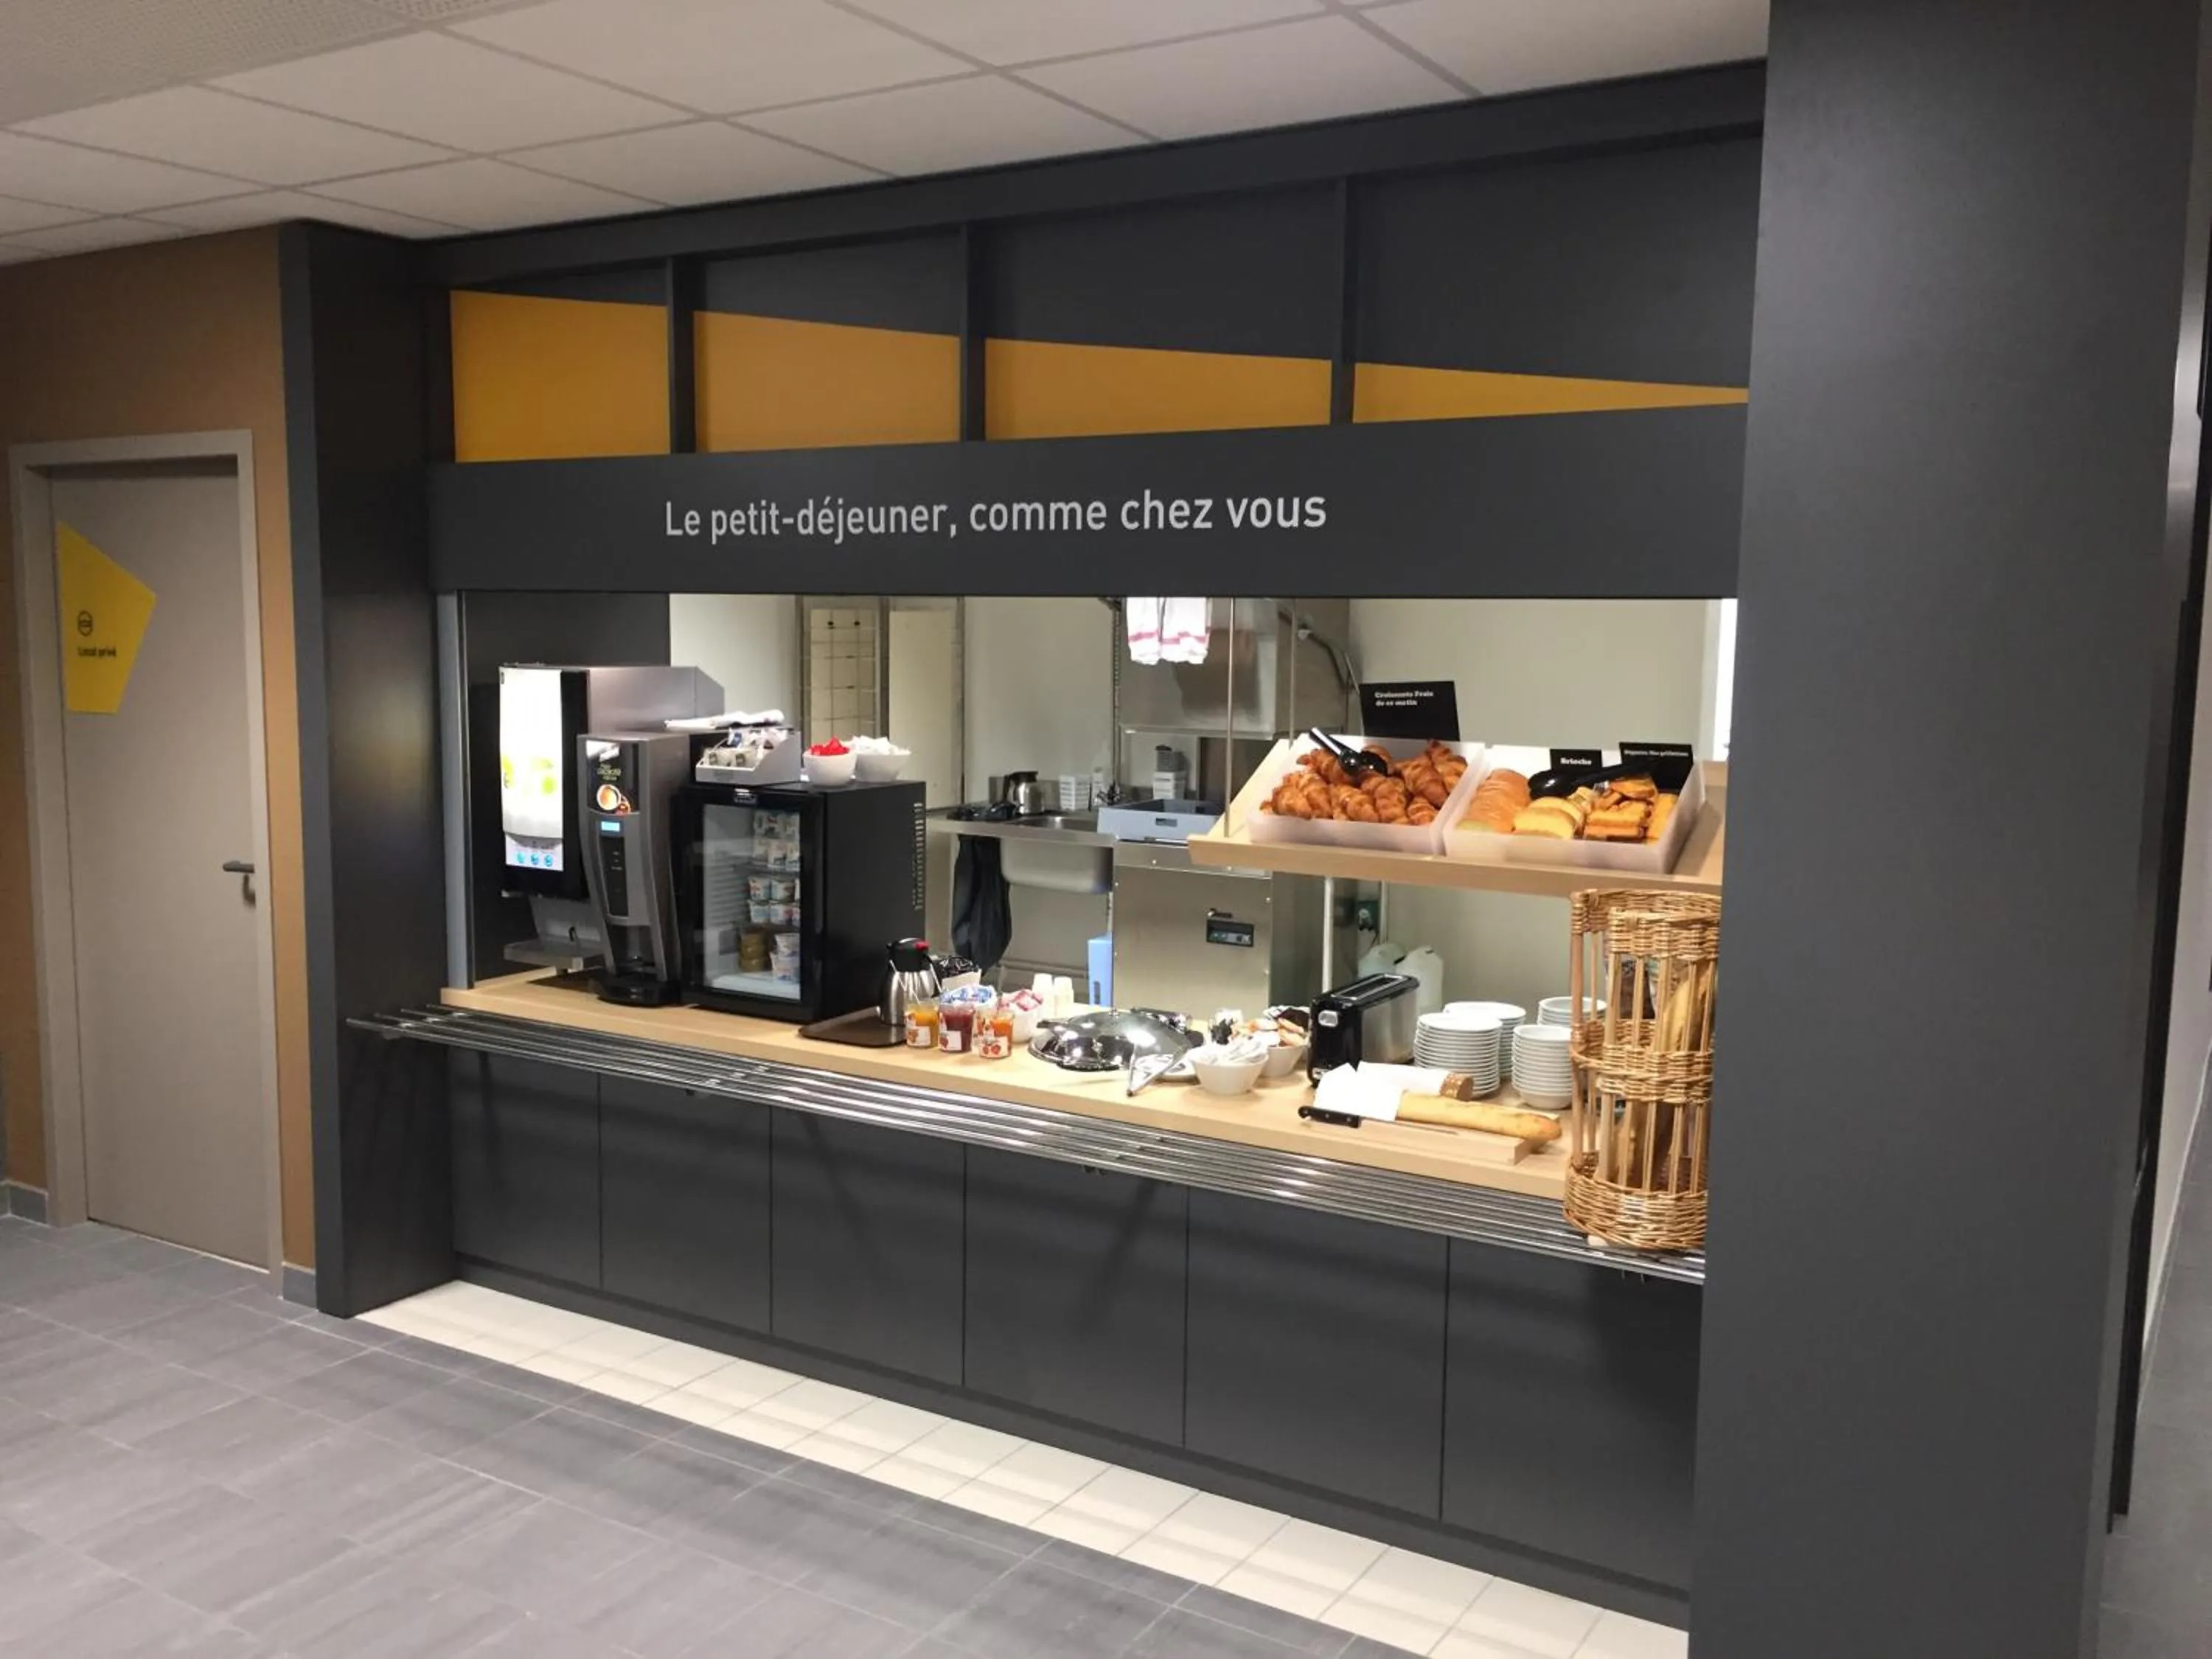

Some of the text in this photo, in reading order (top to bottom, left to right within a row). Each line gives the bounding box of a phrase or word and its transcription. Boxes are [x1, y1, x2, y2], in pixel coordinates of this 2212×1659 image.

[666, 489, 1326, 545] Le petit-déjeuner, comme chez vous
